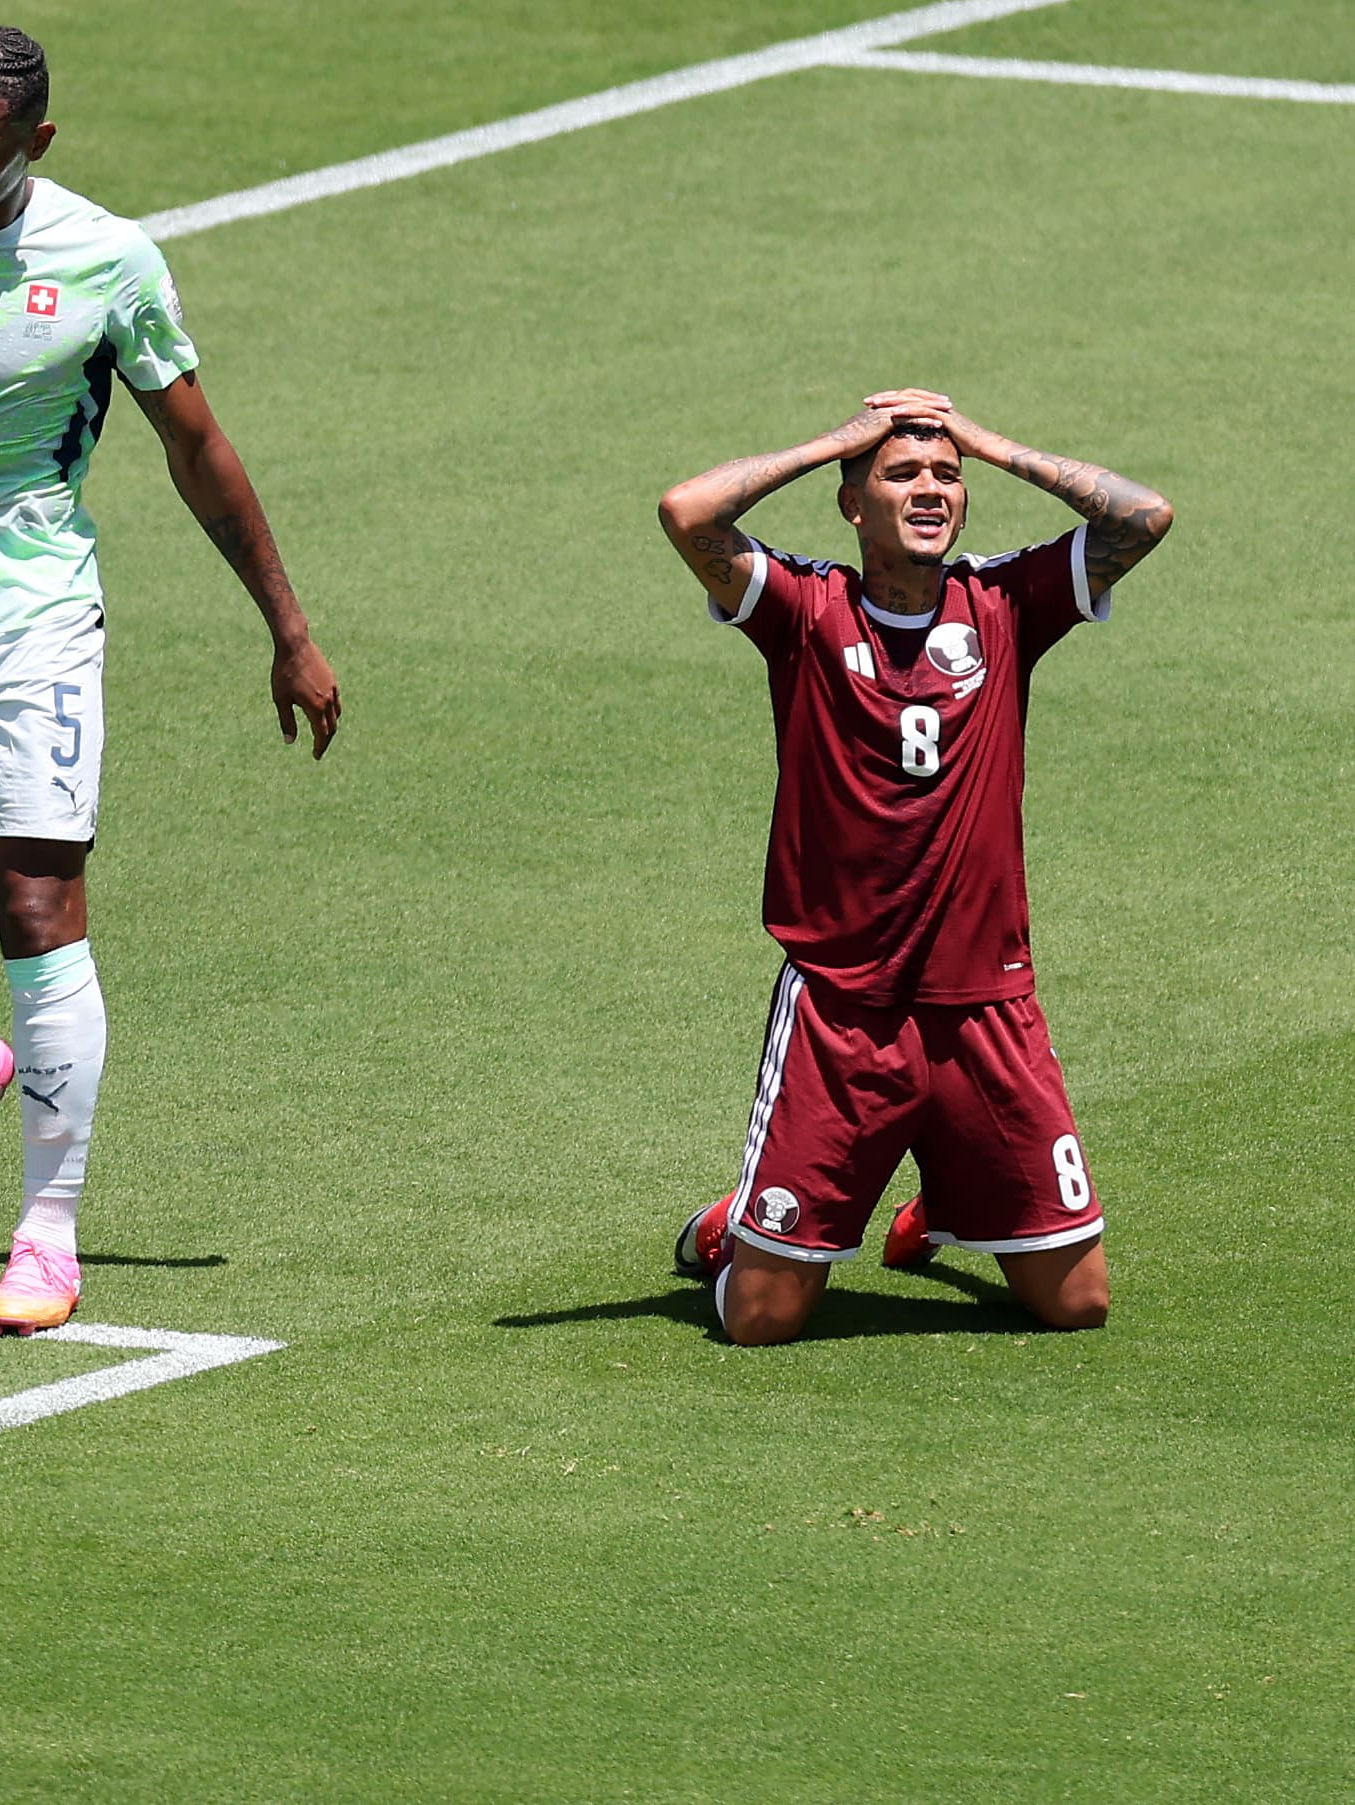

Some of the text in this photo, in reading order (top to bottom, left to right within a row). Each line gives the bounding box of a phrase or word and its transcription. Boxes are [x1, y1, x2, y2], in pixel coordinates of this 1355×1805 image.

[50, 684, 82, 767] 5
[900, 705, 940, 777] 8
[1052, 1134, 1091, 1211] 8
